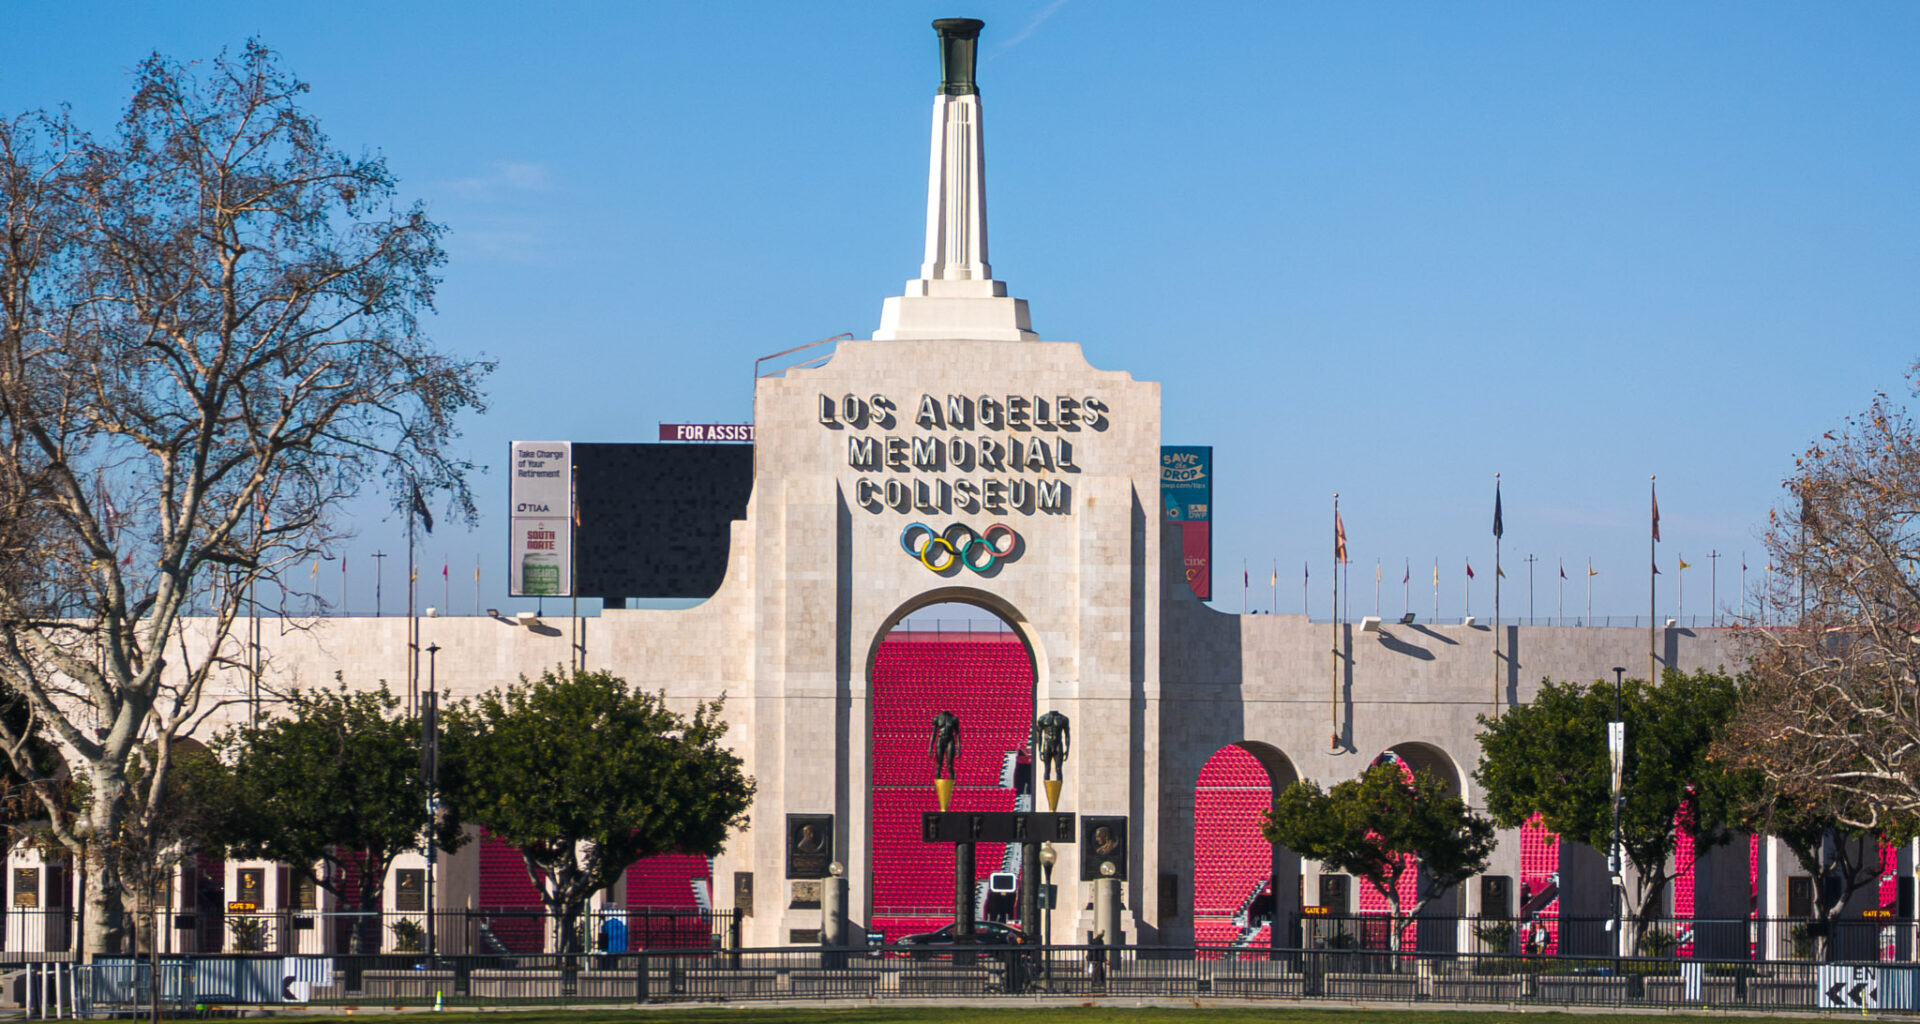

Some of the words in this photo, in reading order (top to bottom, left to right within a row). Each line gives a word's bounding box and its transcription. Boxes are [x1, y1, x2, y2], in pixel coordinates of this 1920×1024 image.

[819, 393, 890, 427] LOS
[915, 394, 1104, 428] ANGELES
[677, 426, 703, 440] FOR
[707, 426, 755, 440] ASSIST
[518, 450, 535, 458] Take
[536, 450, 564, 460] Charge
[849, 436, 1077, 470] MEMORIAL
[518, 460, 526, 468] of
[1163, 453, 1199, 465] SAVE
[518, 469, 560, 478] Retirement
[1163, 469, 1198, 480] DROP
[856, 477, 1066, 512] COLISEUM
[528, 504, 550, 512] TIAA
[527, 531, 555, 540] SOUTH
[527, 541, 555, 550] NORTE
[229, 902, 244, 910] GATE
